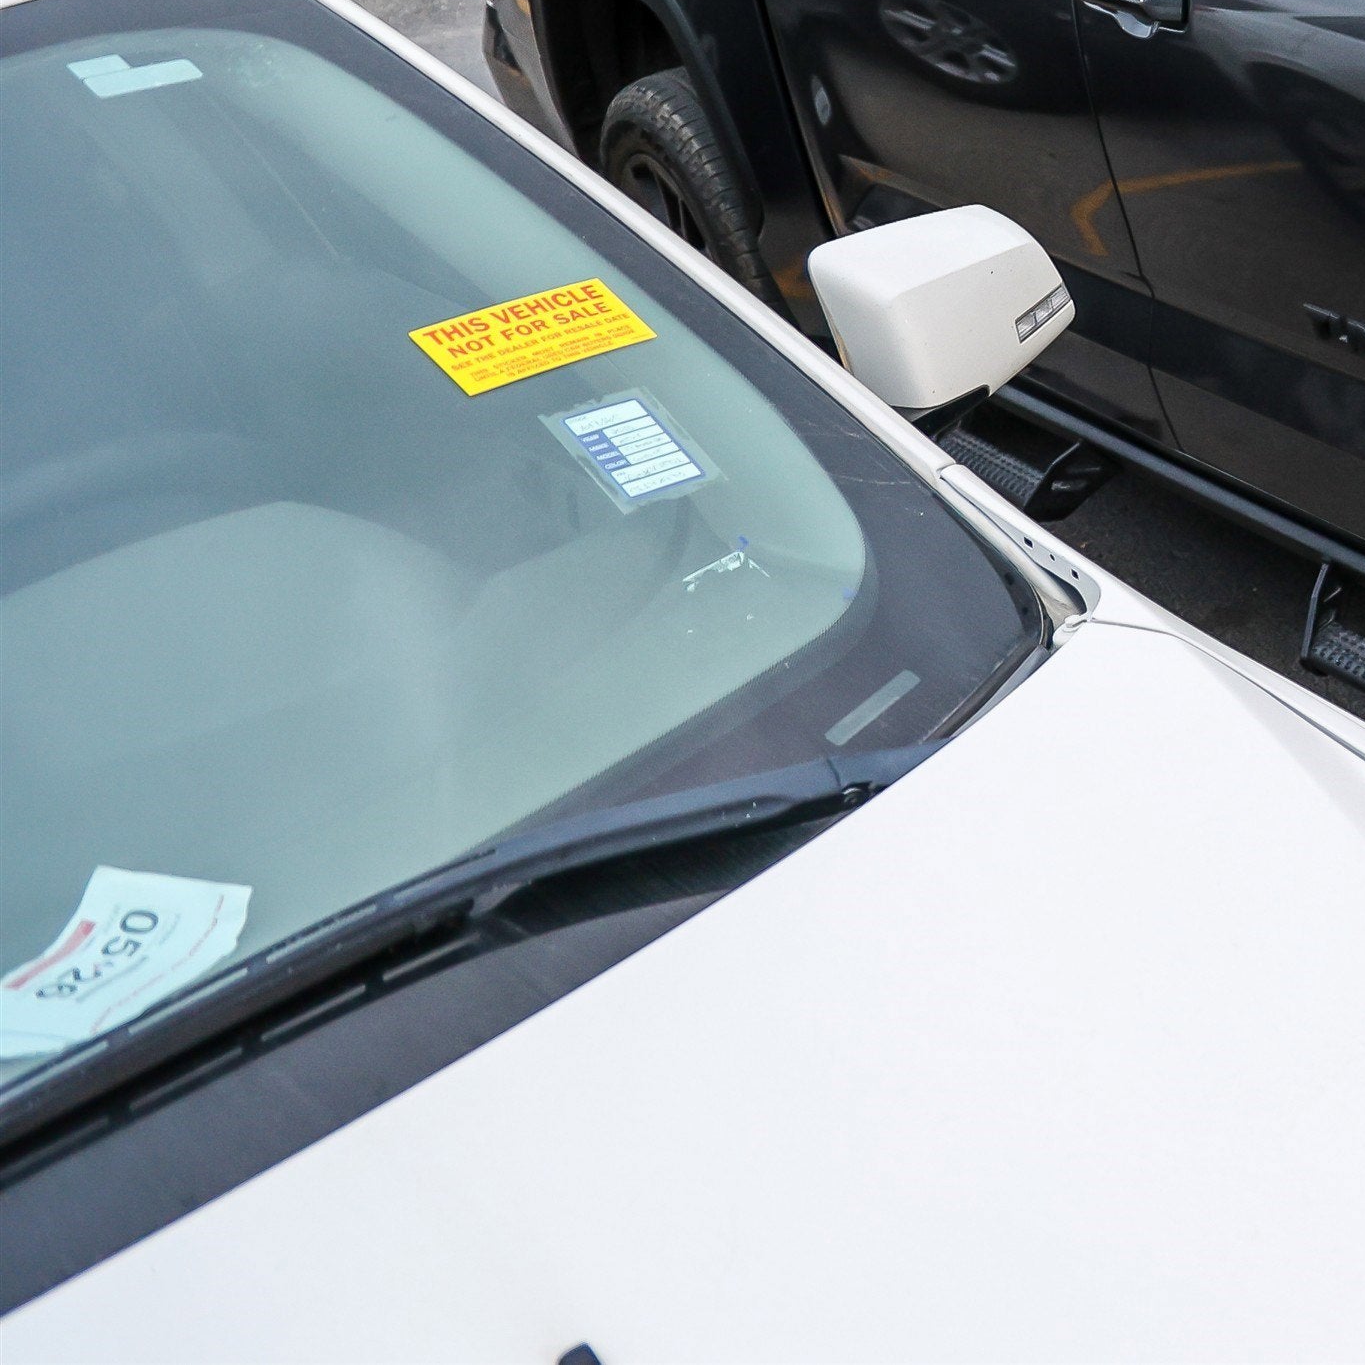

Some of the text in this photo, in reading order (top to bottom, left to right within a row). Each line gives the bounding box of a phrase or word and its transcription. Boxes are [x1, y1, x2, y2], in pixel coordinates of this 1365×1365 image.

[422, 285, 603, 345] THIS VEHICLE
[447, 302, 612, 358] NOT FOR SALE
[451, 312, 630, 371] SEE THE DEALER FOR RESALE DATE
